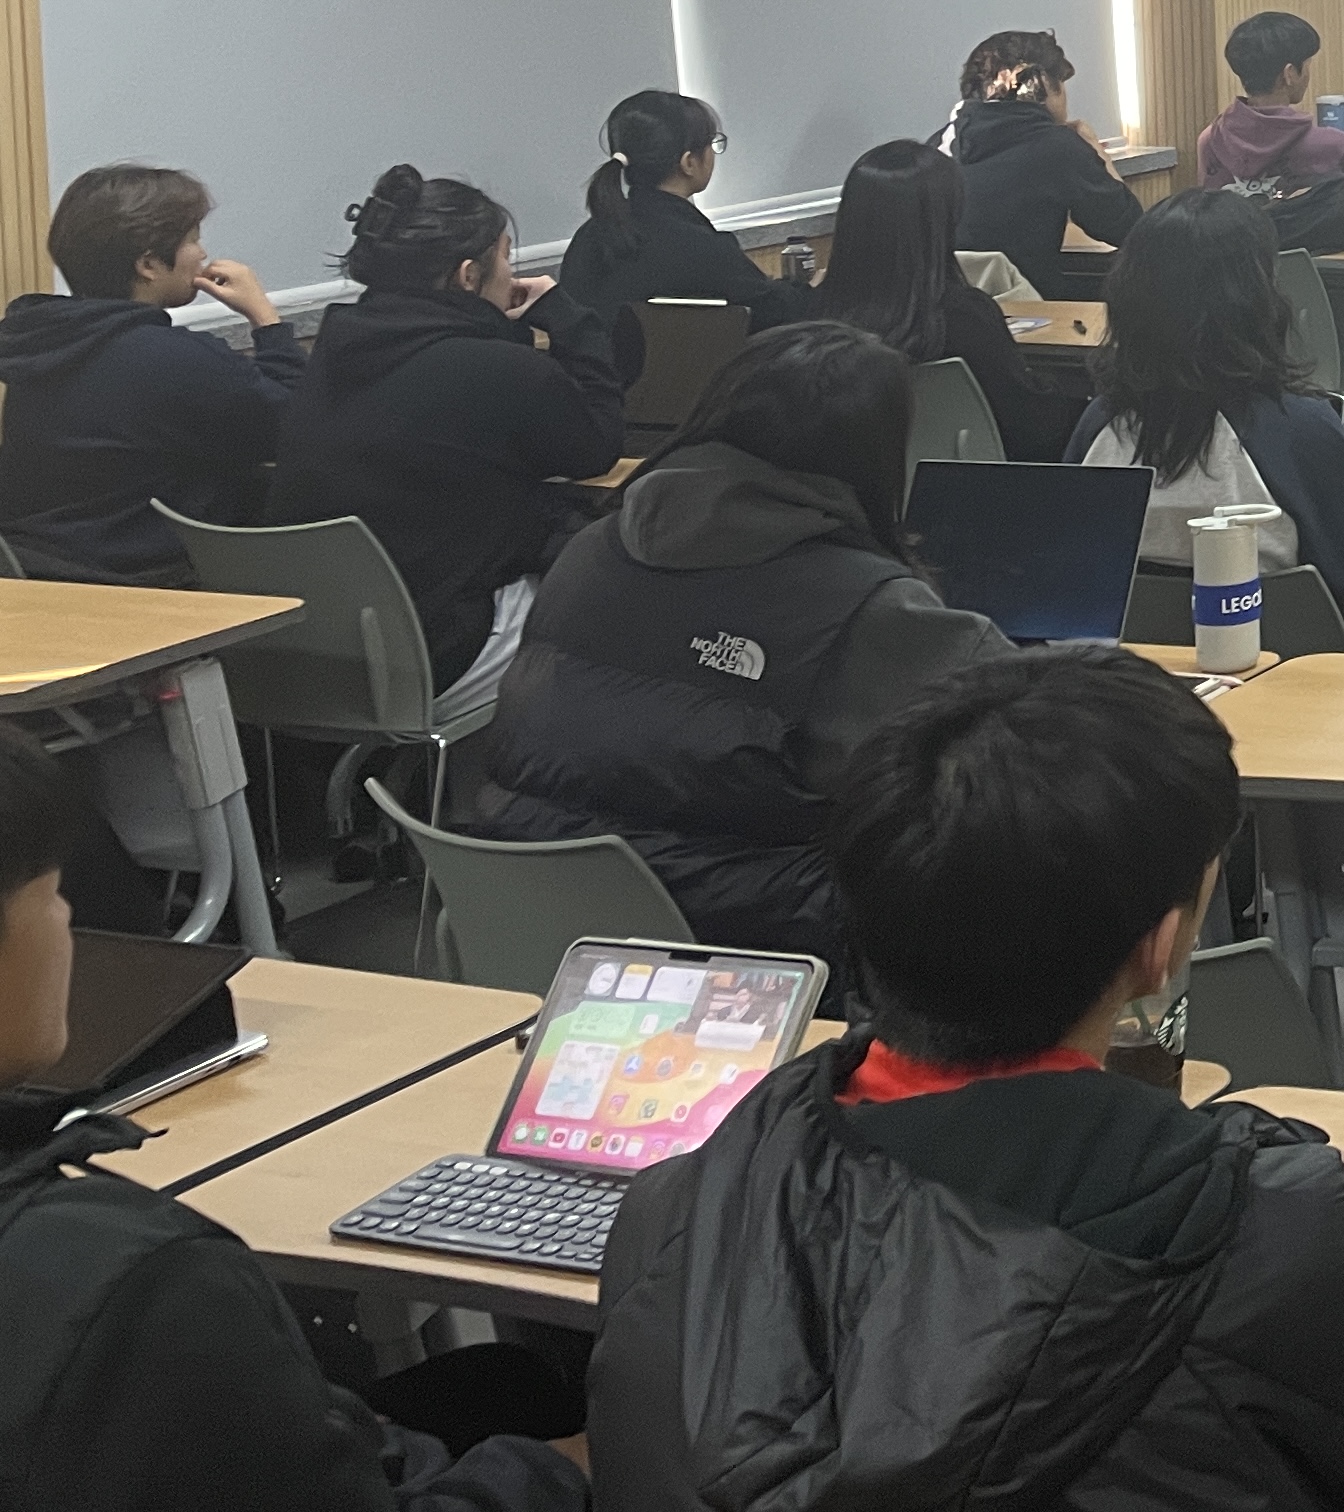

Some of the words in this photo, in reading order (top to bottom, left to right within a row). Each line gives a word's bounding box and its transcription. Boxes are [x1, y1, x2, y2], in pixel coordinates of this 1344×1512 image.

[690, 637, 741, 664] NORTH
[718, 631, 746, 650] THE
[698, 651, 737, 673] FACE
